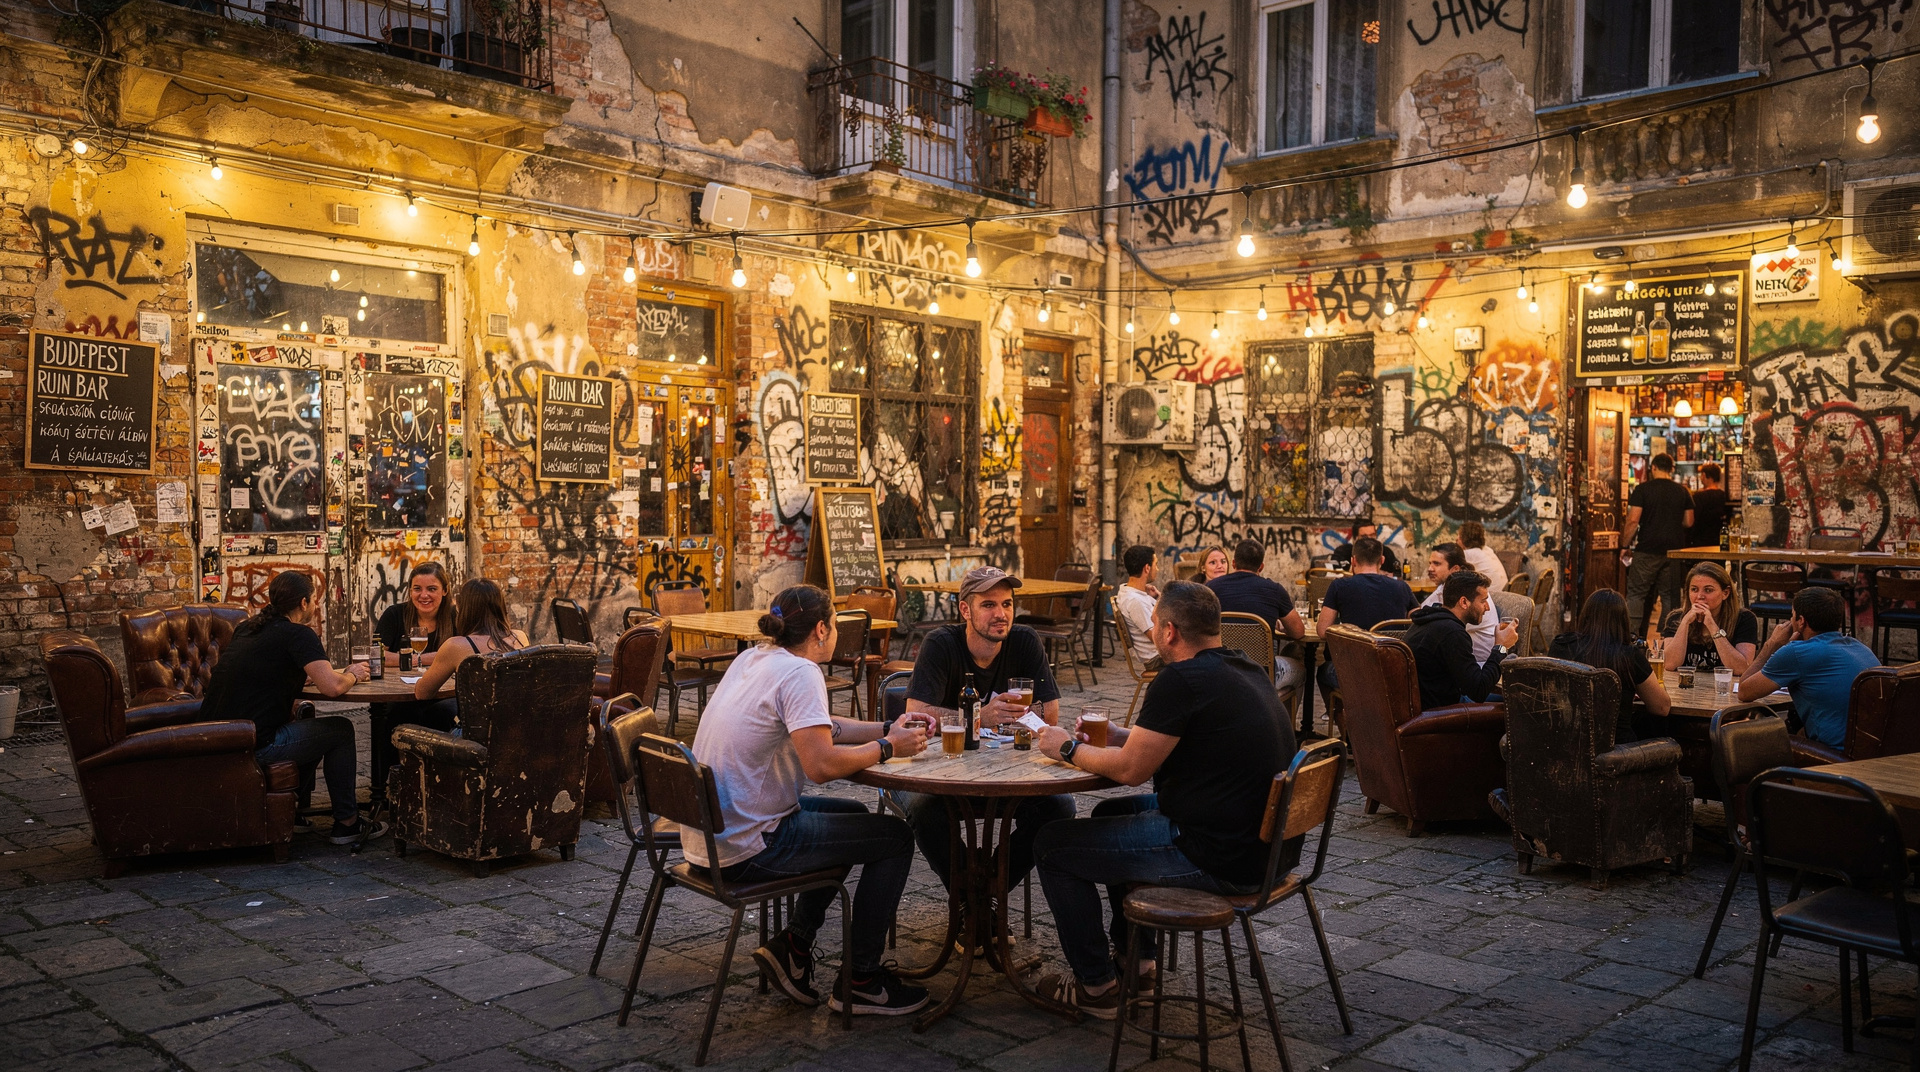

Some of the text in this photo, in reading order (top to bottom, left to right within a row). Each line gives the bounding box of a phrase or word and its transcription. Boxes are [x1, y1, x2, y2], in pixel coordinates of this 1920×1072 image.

[43, 335, 131, 374] BUDEPEST
[37, 369, 109, 401] RUIN BAR
[548, 375, 605, 406] RUIN BAR
